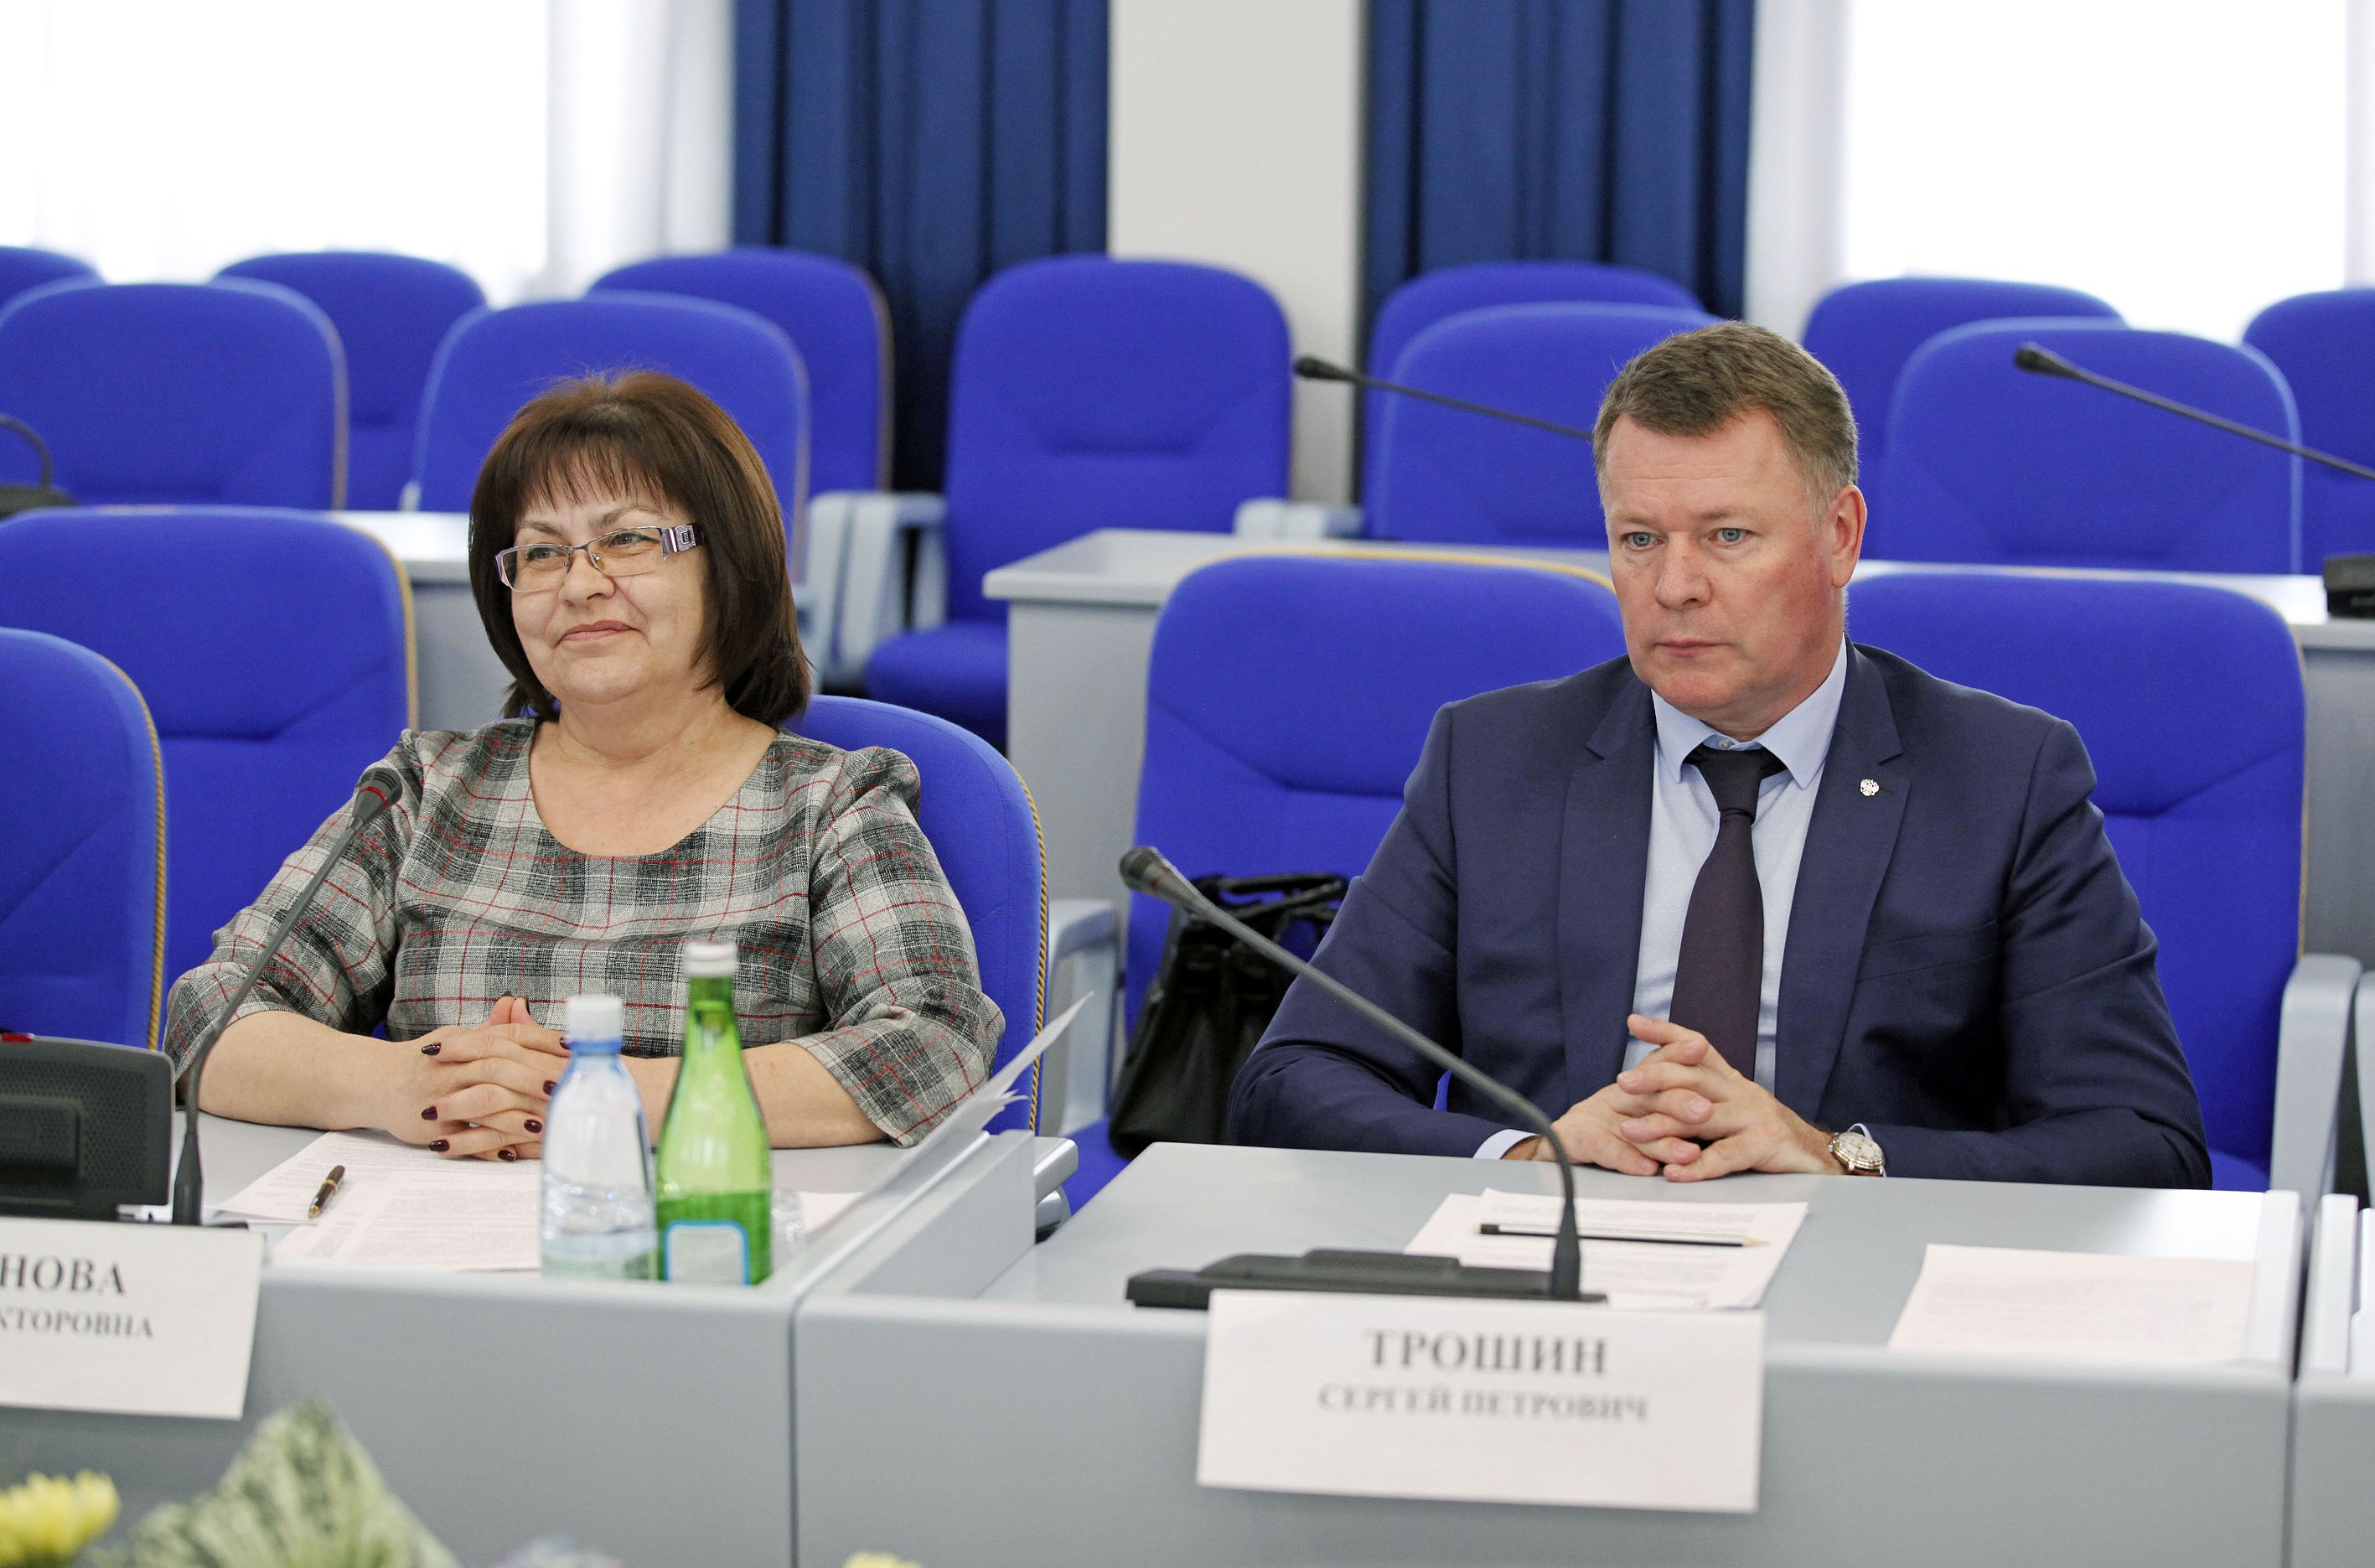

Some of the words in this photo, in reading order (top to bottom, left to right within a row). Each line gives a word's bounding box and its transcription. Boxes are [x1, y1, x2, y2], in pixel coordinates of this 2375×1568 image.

[1364, 1329, 1607, 1376] ТРОШИН
[1317, 1383, 1451, 1414] СЕРГЕЙ
[1462, 1391, 1647, 1422] ПЕТРОВИЧ
